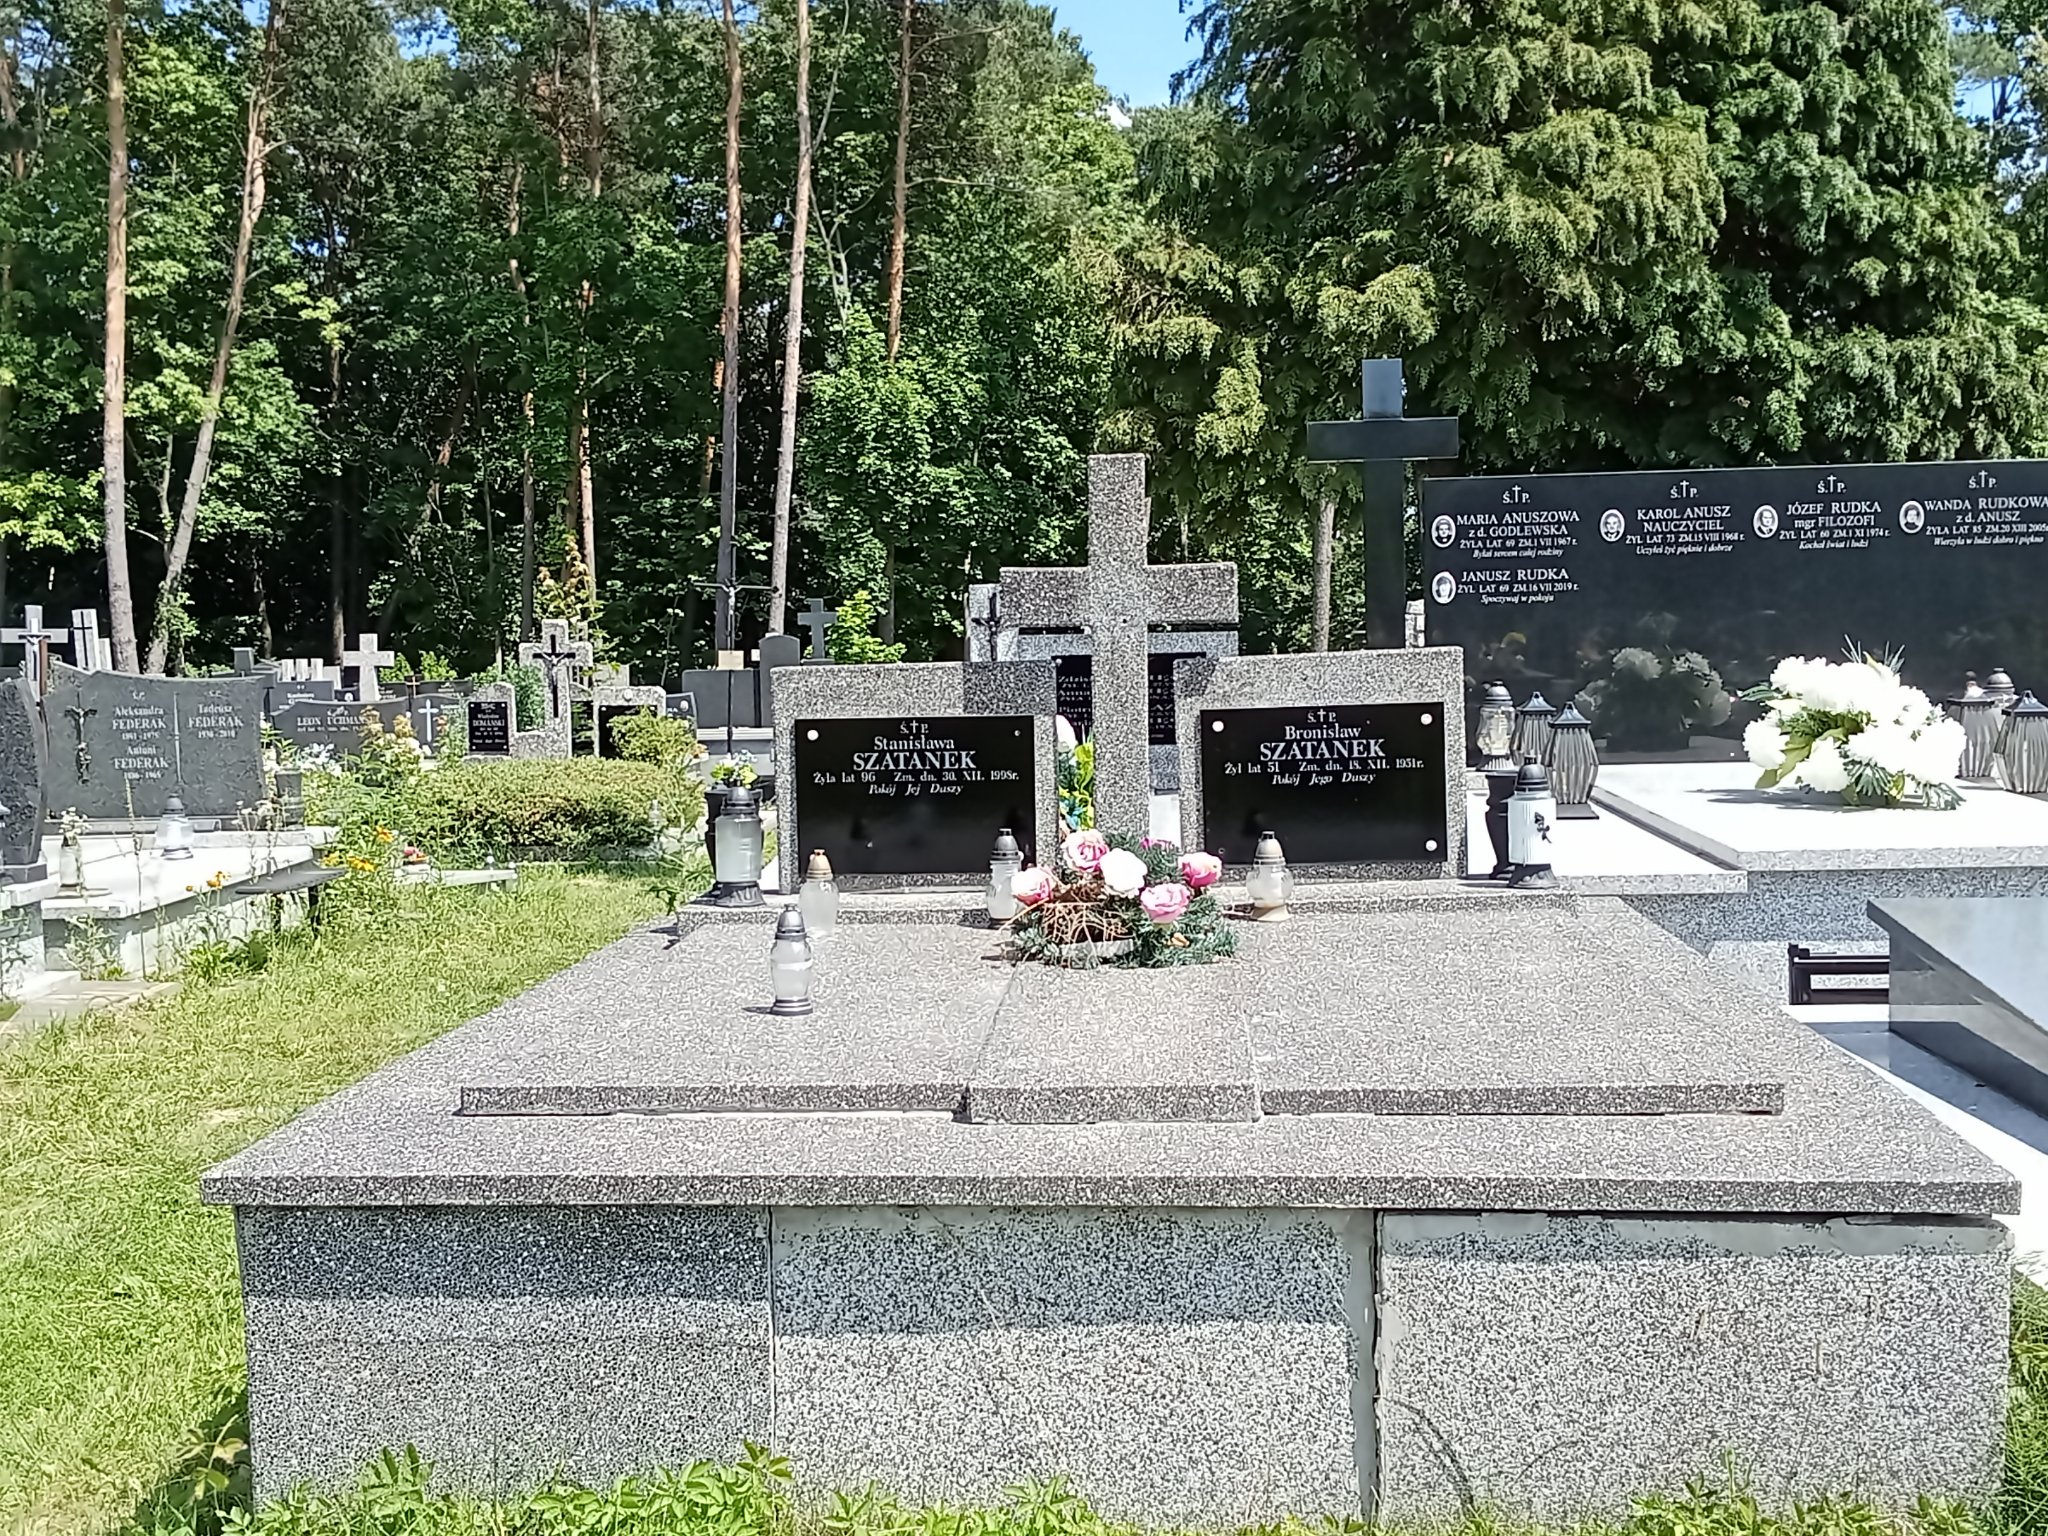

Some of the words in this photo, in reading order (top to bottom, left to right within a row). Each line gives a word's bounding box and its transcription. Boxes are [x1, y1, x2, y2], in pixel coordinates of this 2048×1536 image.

[1786, 501, 1824, 515] JÓZEF
[1831, 502, 1881, 514] RUDKA
[1924, 500, 1972, 511] WANDA
[1978, 496, 2048, 510] RUDKOWA
[1457, 514, 1498, 526] MARIA
[1503, 511, 1580, 524] ANUSZOWA
[1637, 509, 1681, 520] KAROL
[1683, 506, 1731, 518] ANUSZ
[1977, 511, 2021, 522] ANUSZ
[1643, 520, 1724, 532] NAUCZYCIEL
[1794, 520, 1816, 529] mgr
[1818, 515, 1875, 527] FILOZOFI
[1490, 525, 1568, 537] GODLEWSKA
[1801, 530, 1817, 539] LAT
[1866, 528, 1884, 537] 1974
[1952, 525, 1969, 534] LAT
[1486, 540, 1503, 548] LAT
[1554, 537, 1571, 546] 1967
[1646, 535, 1662, 543] LAT
[1461, 570, 1511, 582] JANUSZ
[1517, 568, 1569, 580] RUDKA
[1480, 584, 1496, 593] LAT
[1553, 582, 1573, 591] 2019
[115, 705, 164, 717] Aleksandra
[112, 718, 166, 730] FEDERAK
[188, 716, 243, 728] FEDERAK
[297, 716, 321, 725] LEON
[1285, 723, 1361, 740] Bronisław
[874, 736, 955, 750] Stanisława
[127, 745, 157, 755] Antoni
[1260, 738, 1386, 761] SZATANEK
[114, 757, 169, 769] FEDERAK
[853, 751, 976, 770] SZATANEK
[1225, 762, 1242, 774] Żył
[1248, 762, 1261, 773] lat
[1267, 762, 1280, 772] 51
[1299, 761, 1320, 771] Zm.
[1325, 760, 1343, 771] dn.
[1367, 760, 1390, 769] XII.
[813, 772, 836, 785] Żyła
[842, 772, 855, 782] lat
[861, 772, 876, 782] 96
[894, 772, 915, 782] Zm.
[920, 771, 937, 781] dn.
[942, 771, 957, 781] 30.
[963, 771, 985, 781] XII.
[1272, 775, 1300, 785] Pokój
[1309, 773, 1333, 786] Jego
[1342, 772, 1376, 784] Duszy
[869, 784, 896, 796] Pokój
[905, 784, 920, 796] Jej
[930, 783, 963, 795] Duszy
